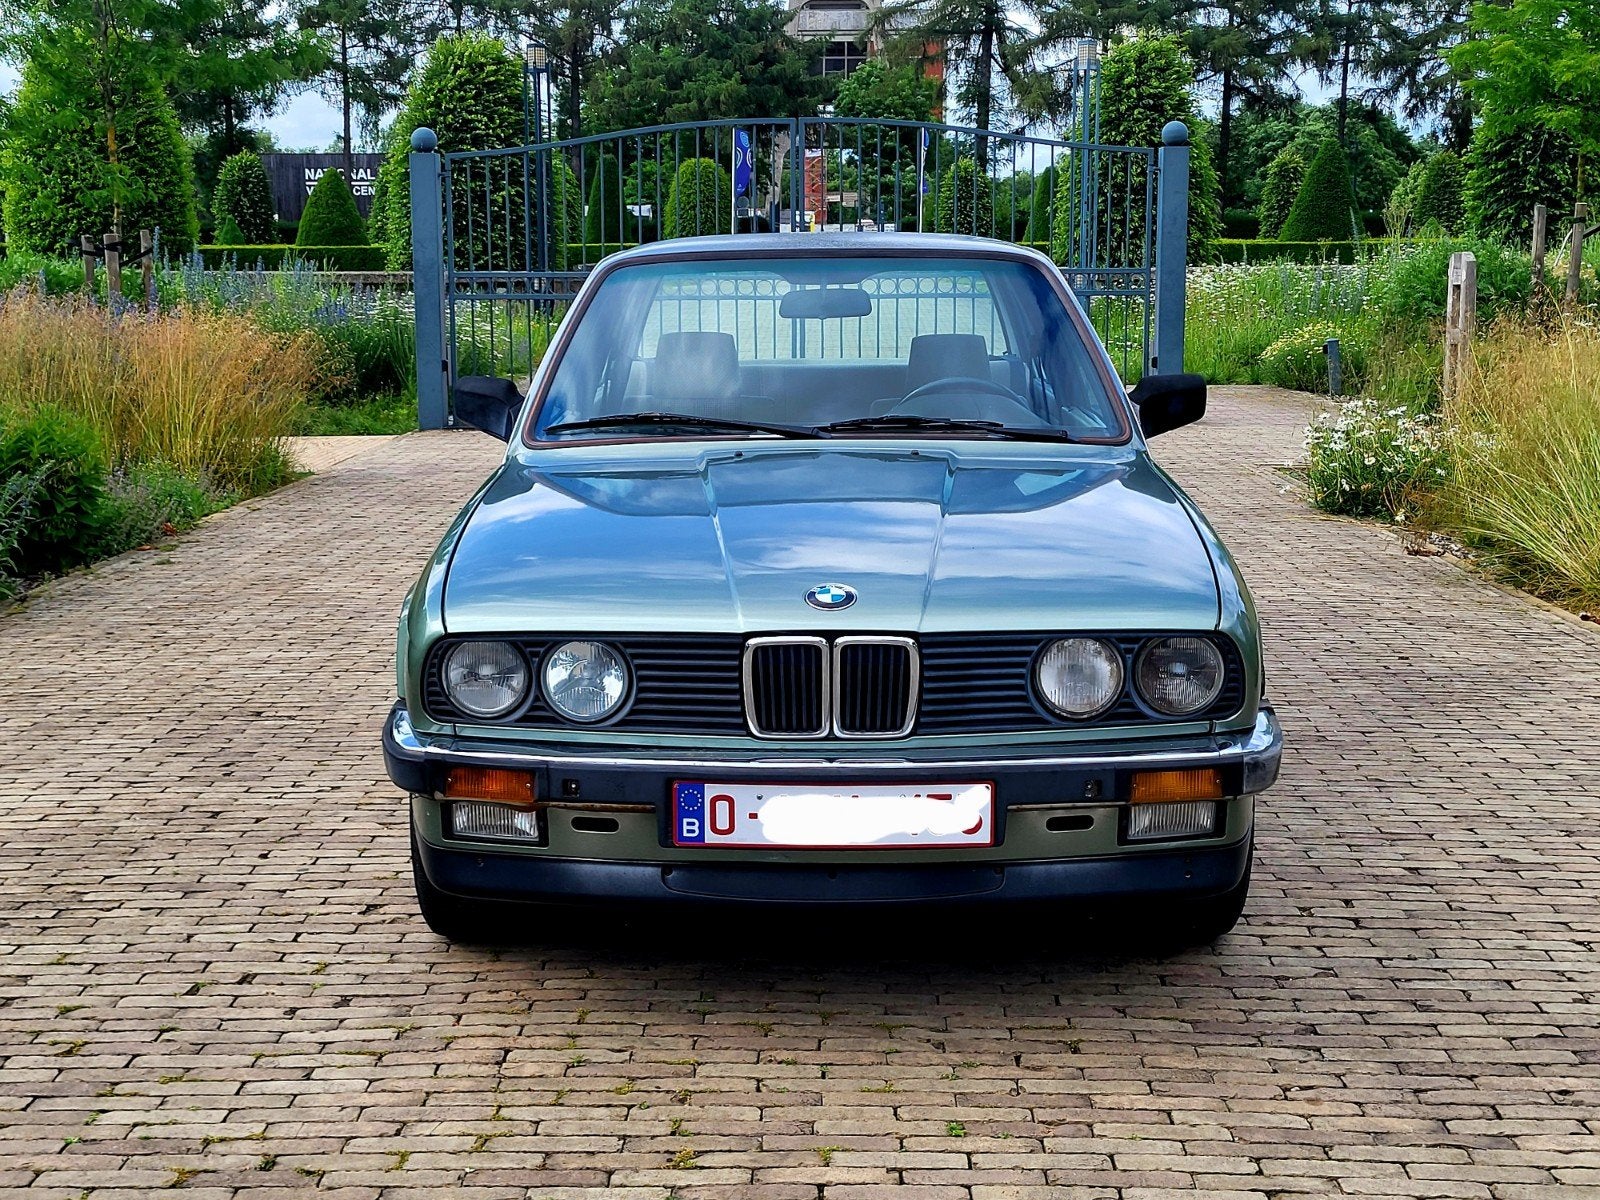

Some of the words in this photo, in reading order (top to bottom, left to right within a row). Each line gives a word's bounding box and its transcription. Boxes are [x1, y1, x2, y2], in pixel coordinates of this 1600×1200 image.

[305, 168, 375, 180] NANAL
[353, 186, 375, 195] CEN
[682, 817, 700, 837] B
